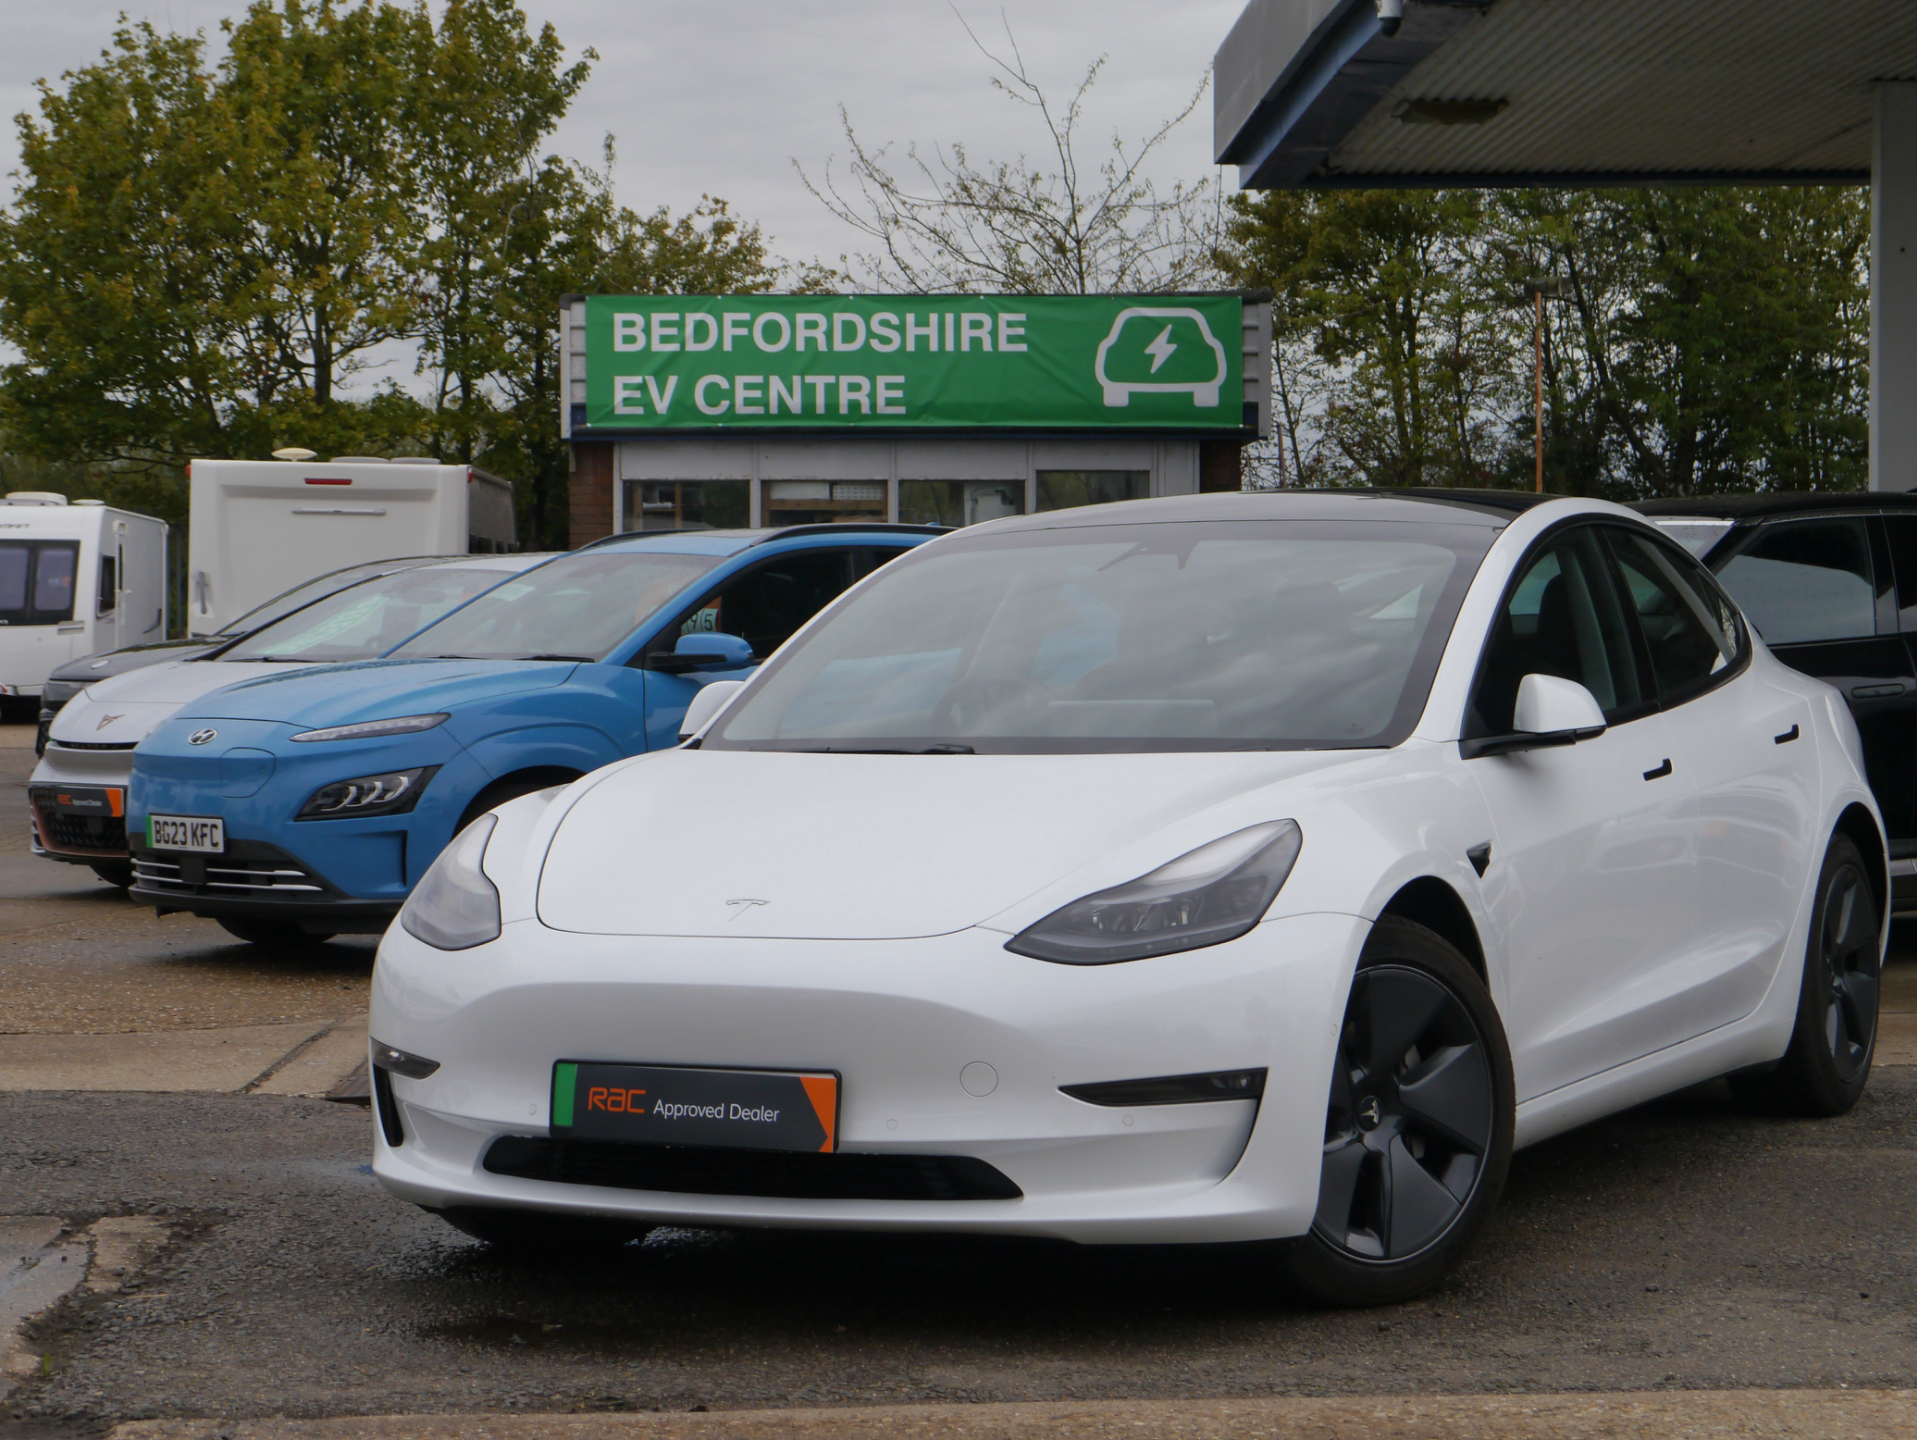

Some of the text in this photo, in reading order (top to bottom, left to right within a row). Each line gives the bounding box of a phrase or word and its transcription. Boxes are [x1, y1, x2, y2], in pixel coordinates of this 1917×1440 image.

[612, 311, 1028, 353] BEDFORDSHIRE
[612, 374, 907, 415] EV CENTRE
[154, 820, 219, 848] BG23 KFC
[653, 1099, 724, 1120] Approved
[730, 1103, 780, 1122] Dealer
